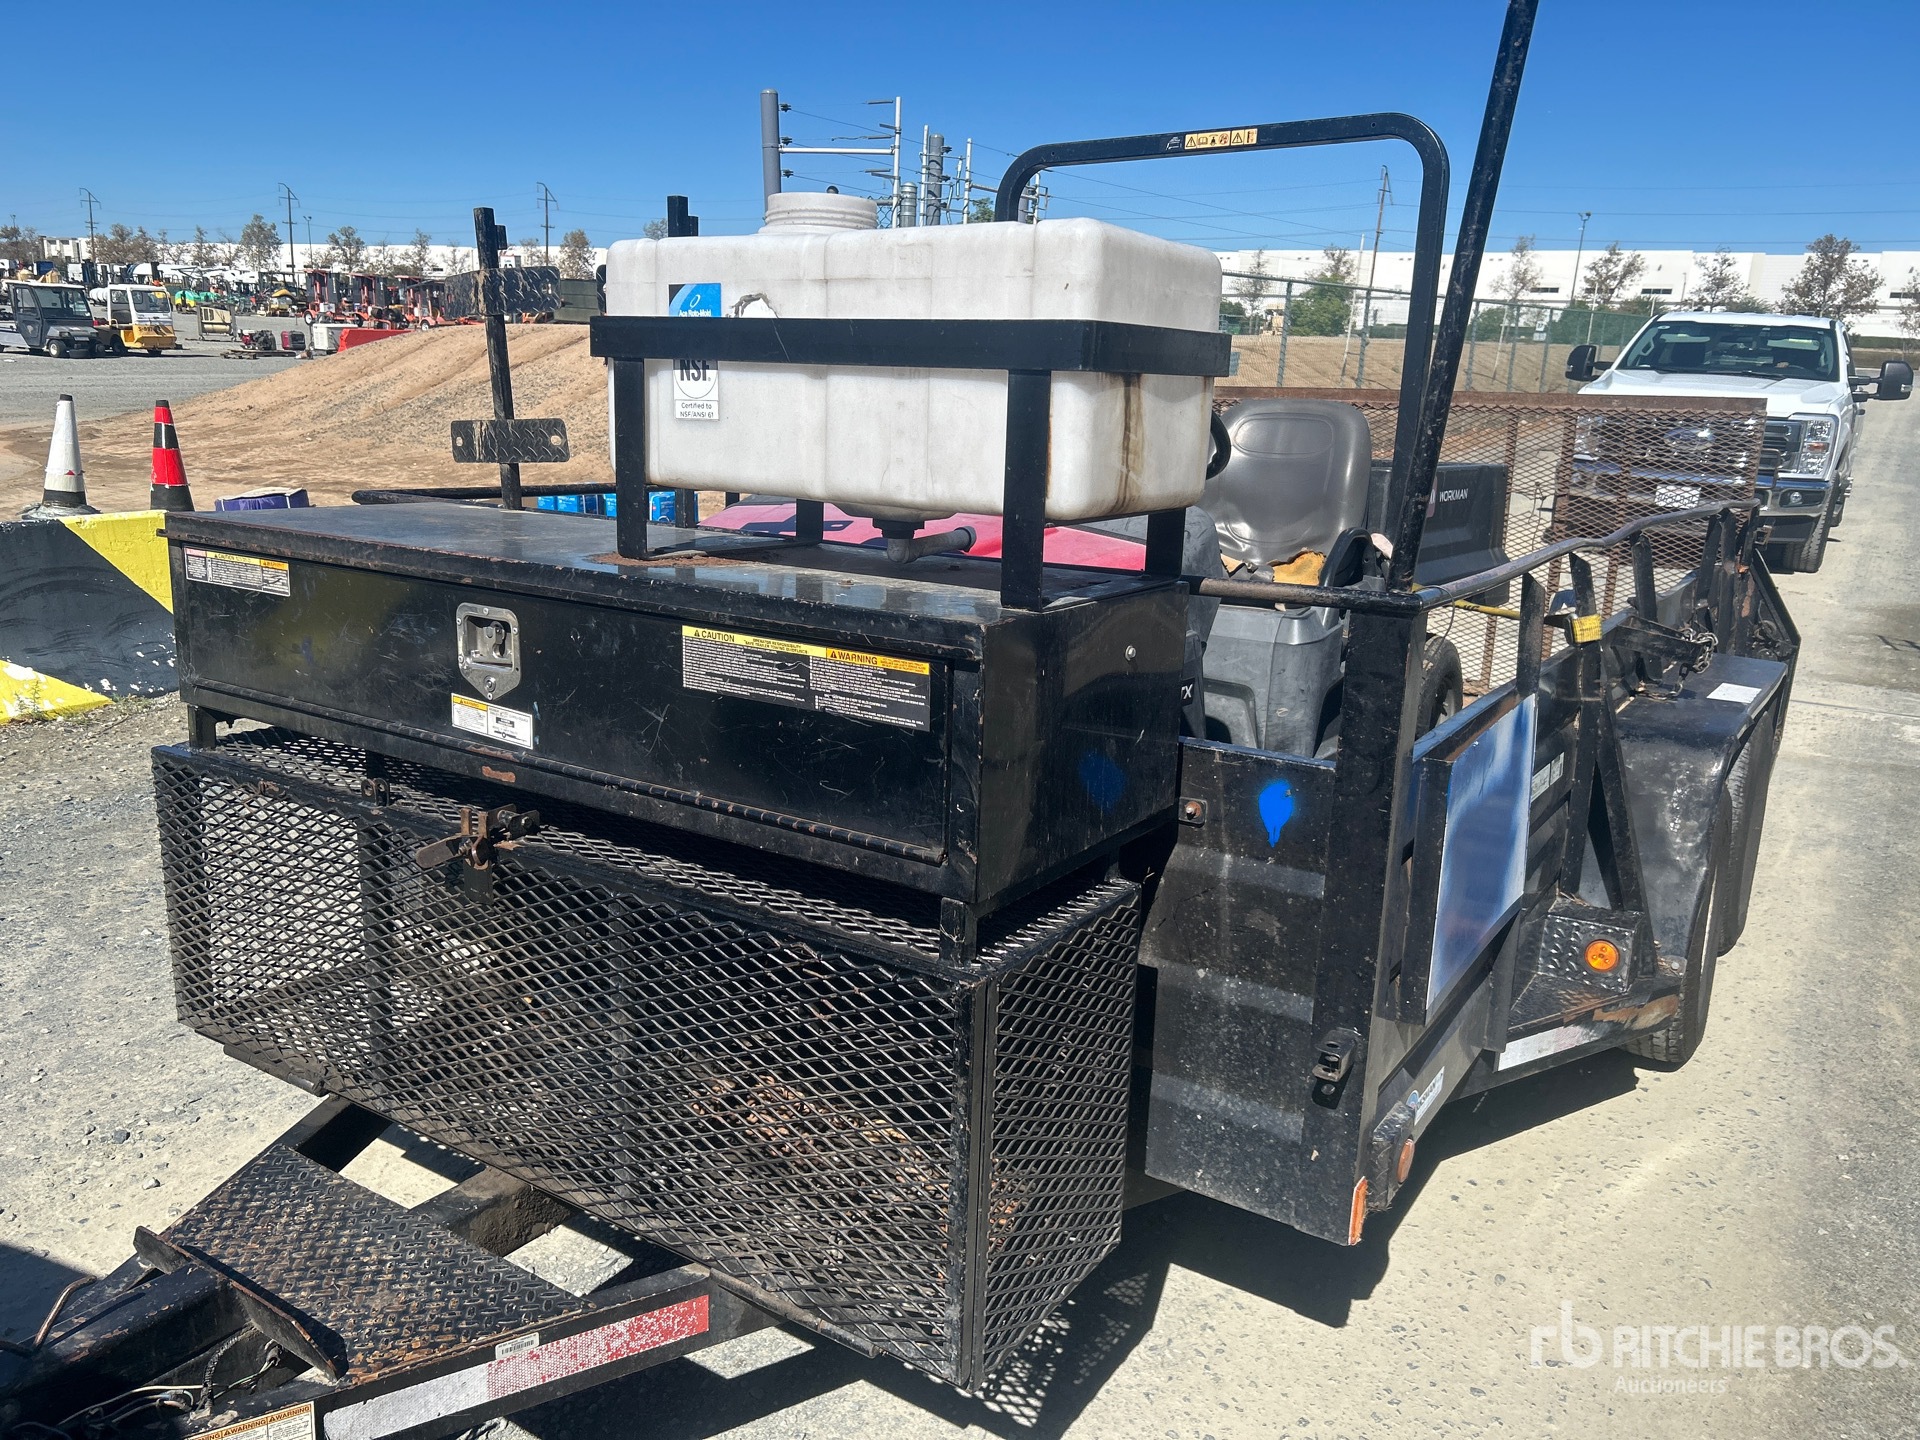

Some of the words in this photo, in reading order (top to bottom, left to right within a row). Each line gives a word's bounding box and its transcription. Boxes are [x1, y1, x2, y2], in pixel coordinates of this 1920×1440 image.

[680, 359, 709, 381] NSF
[1439, 488, 1469, 502] WORKMAN
[701, 630, 735, 643] CAUTION
[837, 651, 878, 665] WARNING
[275, 1406, 310, 1421] WARNING
[230, 1420, 267, 1434] WARNING
